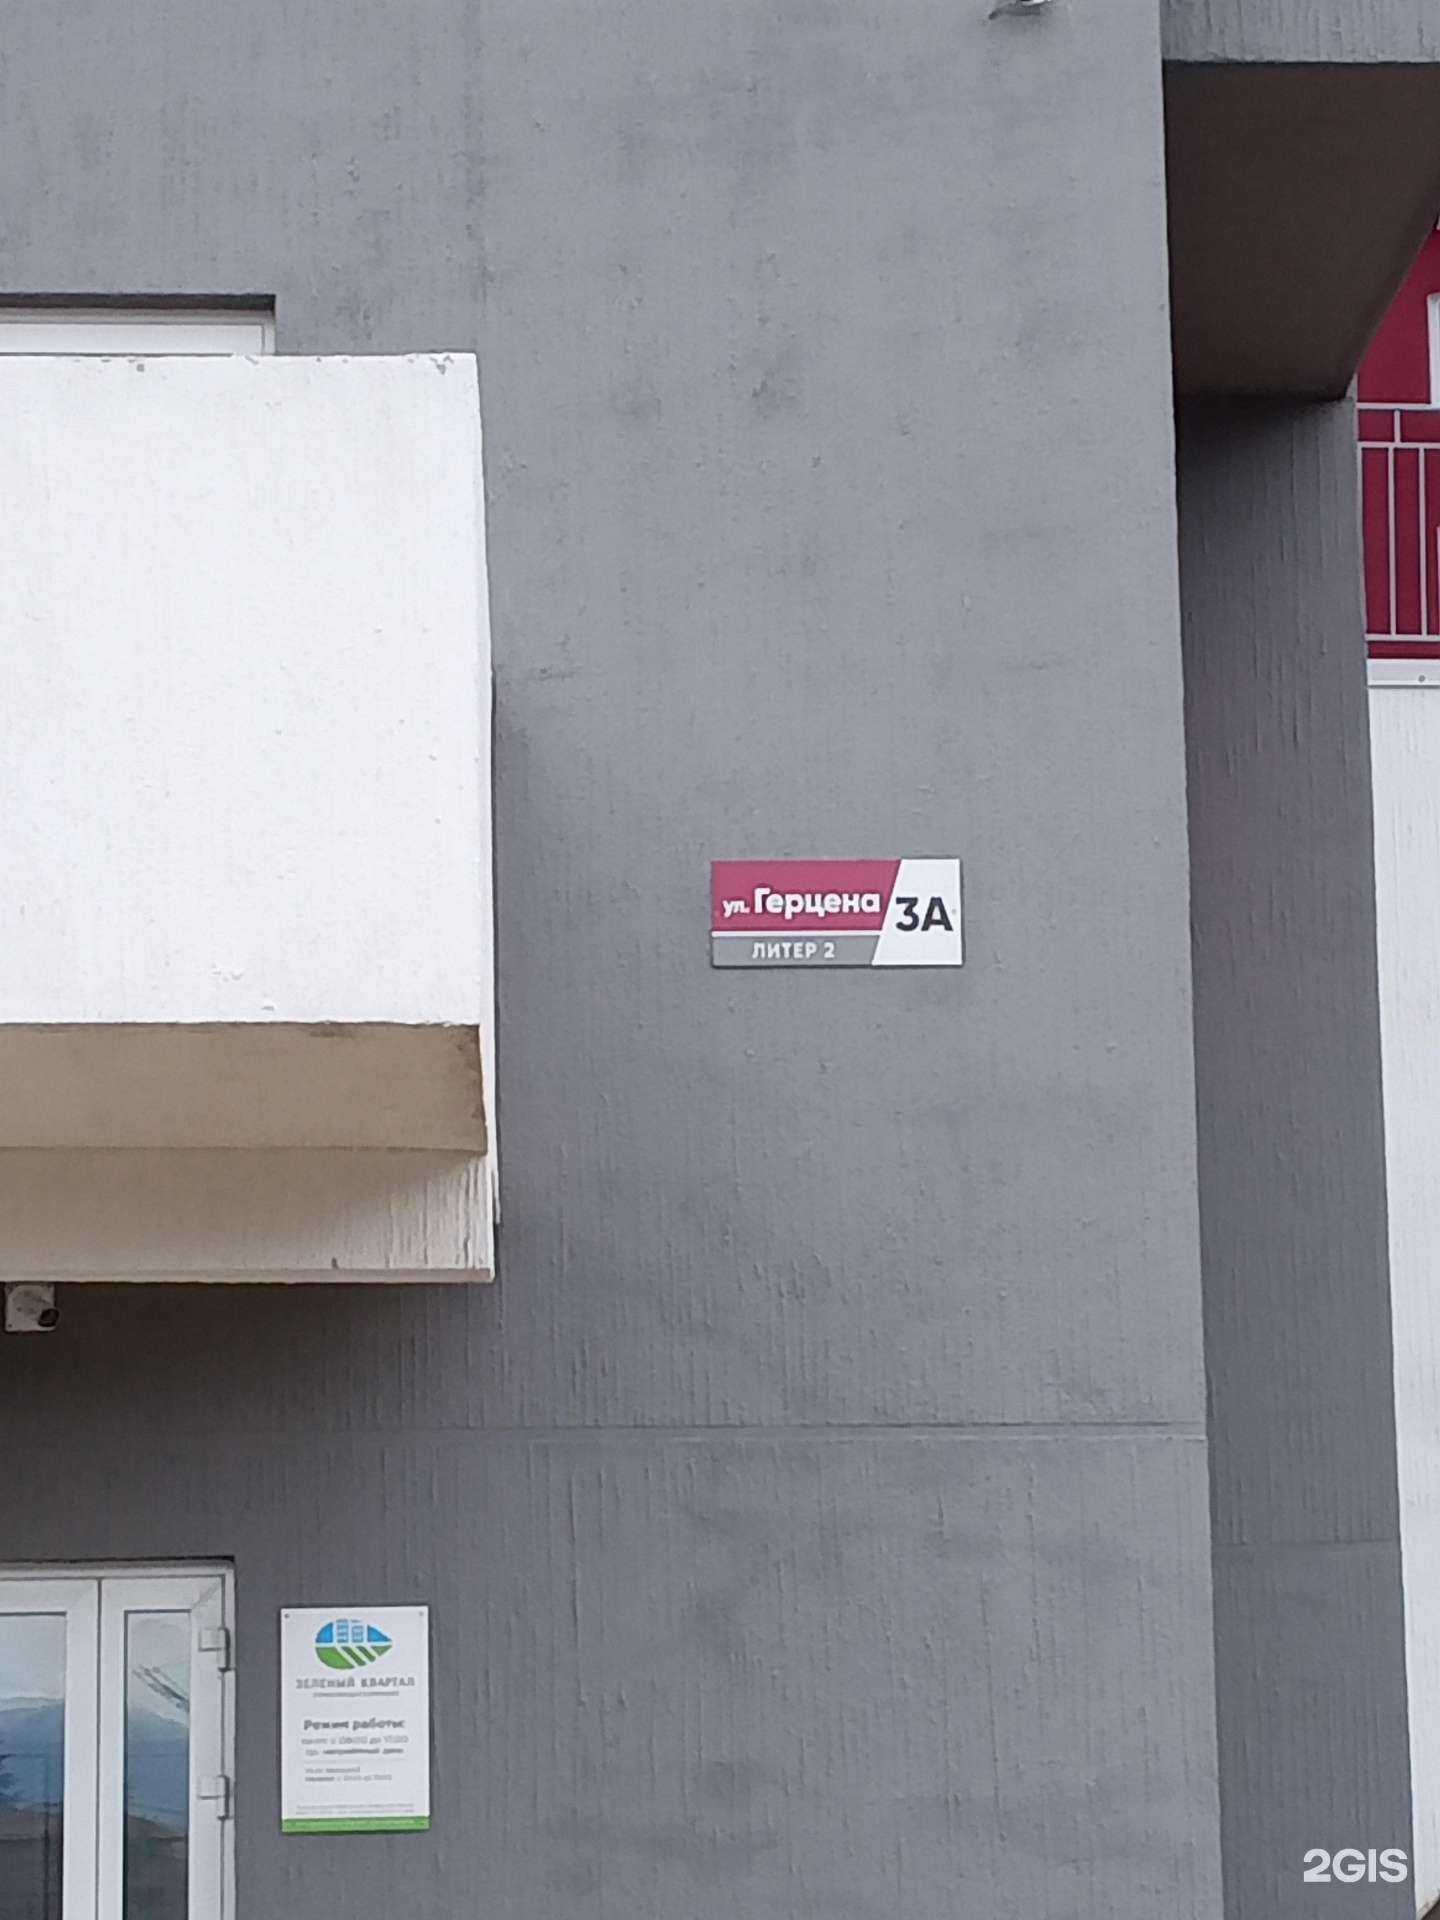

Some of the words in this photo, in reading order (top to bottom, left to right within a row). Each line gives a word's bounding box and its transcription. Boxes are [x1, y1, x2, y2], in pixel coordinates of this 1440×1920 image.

[723, 899, 749, 917] ул.
[754, 888, 880, 919] Герцена
[896, 897, 953, 931] 3А
[752, 942, 817, 958] ЛИТЕР
[824, 942, 835, 958] 2
